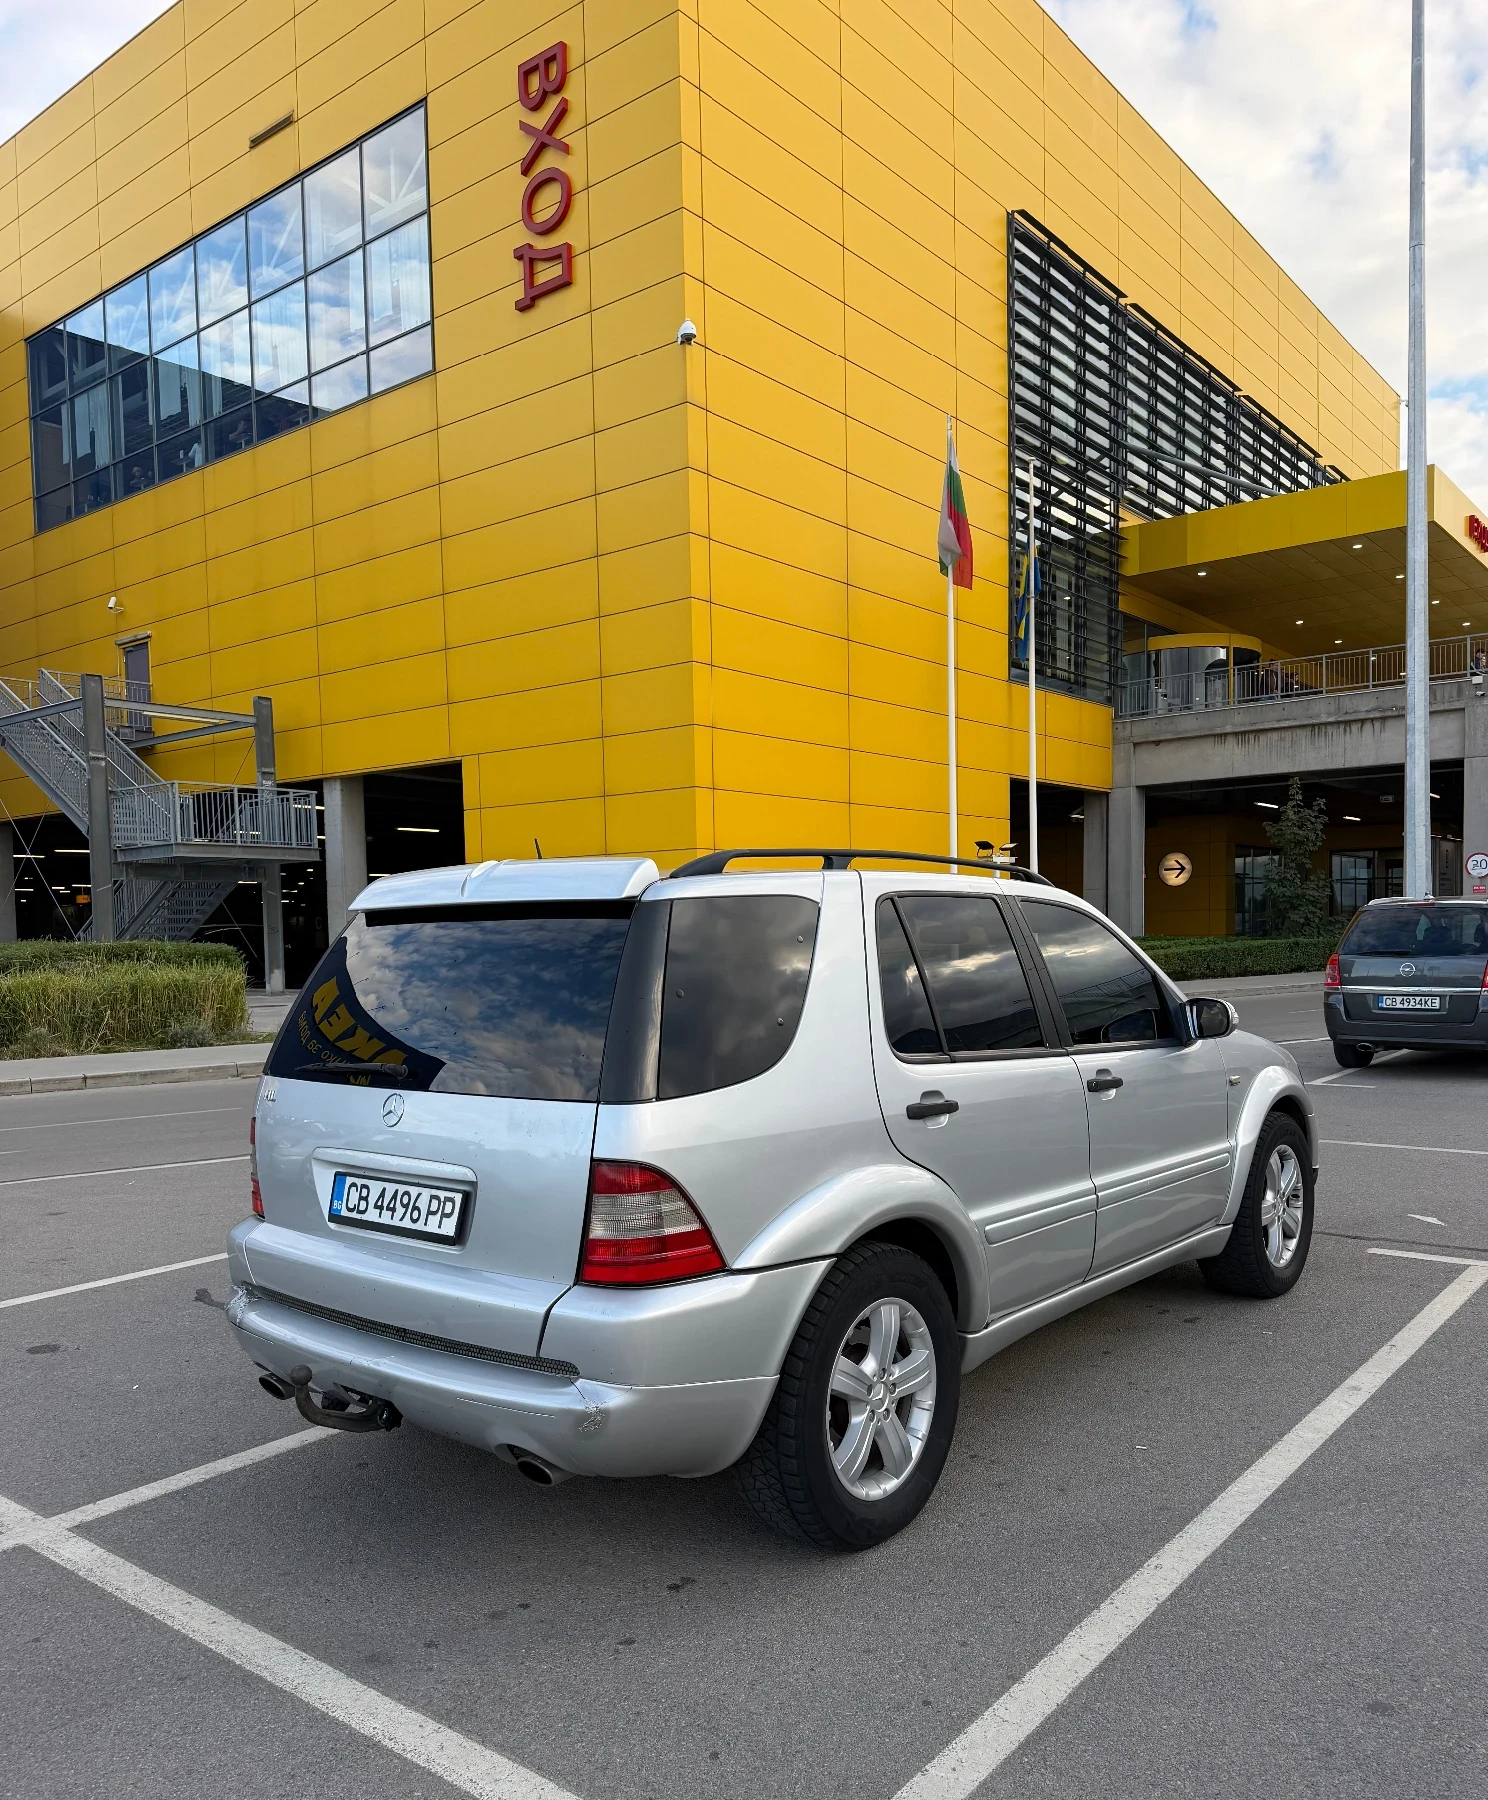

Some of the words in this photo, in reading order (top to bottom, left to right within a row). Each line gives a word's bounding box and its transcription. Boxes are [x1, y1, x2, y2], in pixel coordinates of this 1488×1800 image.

[513, 41, 573, 313] ВХОД
[1472, 859, 1488, 870] 20
[1384, 997, 1397, 1007] CB
[333, 1199, 342, 1210] BG
[345, 1182, 371, 1215] CB
[373, 1187, 423, 1224] 4496
[424, 1194, 456, 1229] PP
